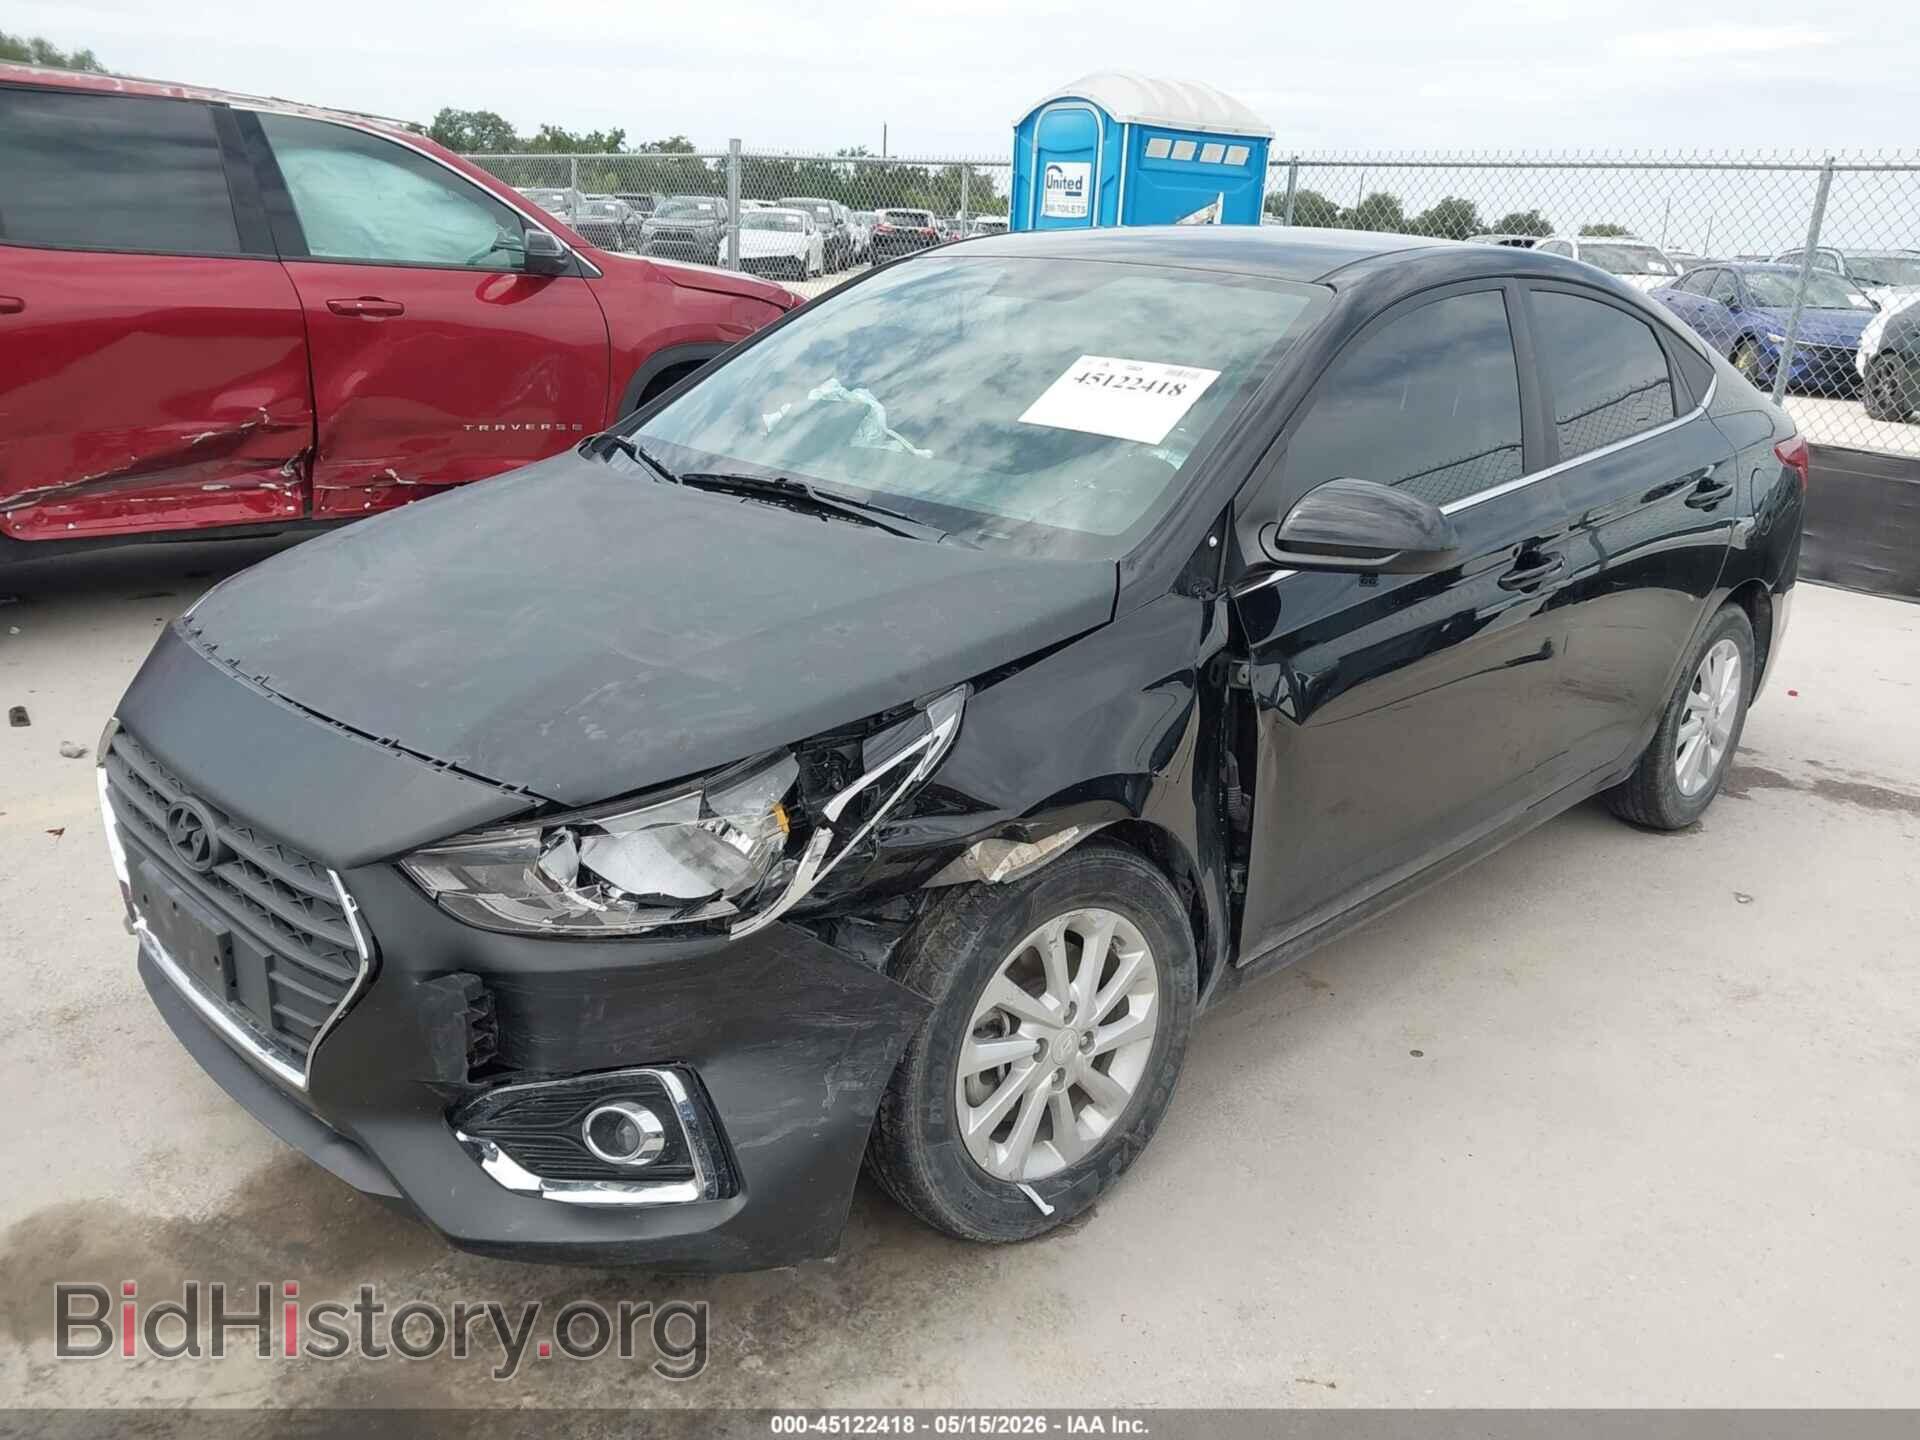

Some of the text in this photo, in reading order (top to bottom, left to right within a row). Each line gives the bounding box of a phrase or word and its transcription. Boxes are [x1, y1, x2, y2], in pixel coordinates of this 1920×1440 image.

[1047, 174, 1083, 190] United
[1074, 371, 1188, 397] 45122418
[463, 423, 583, 432] TRAVERSE
